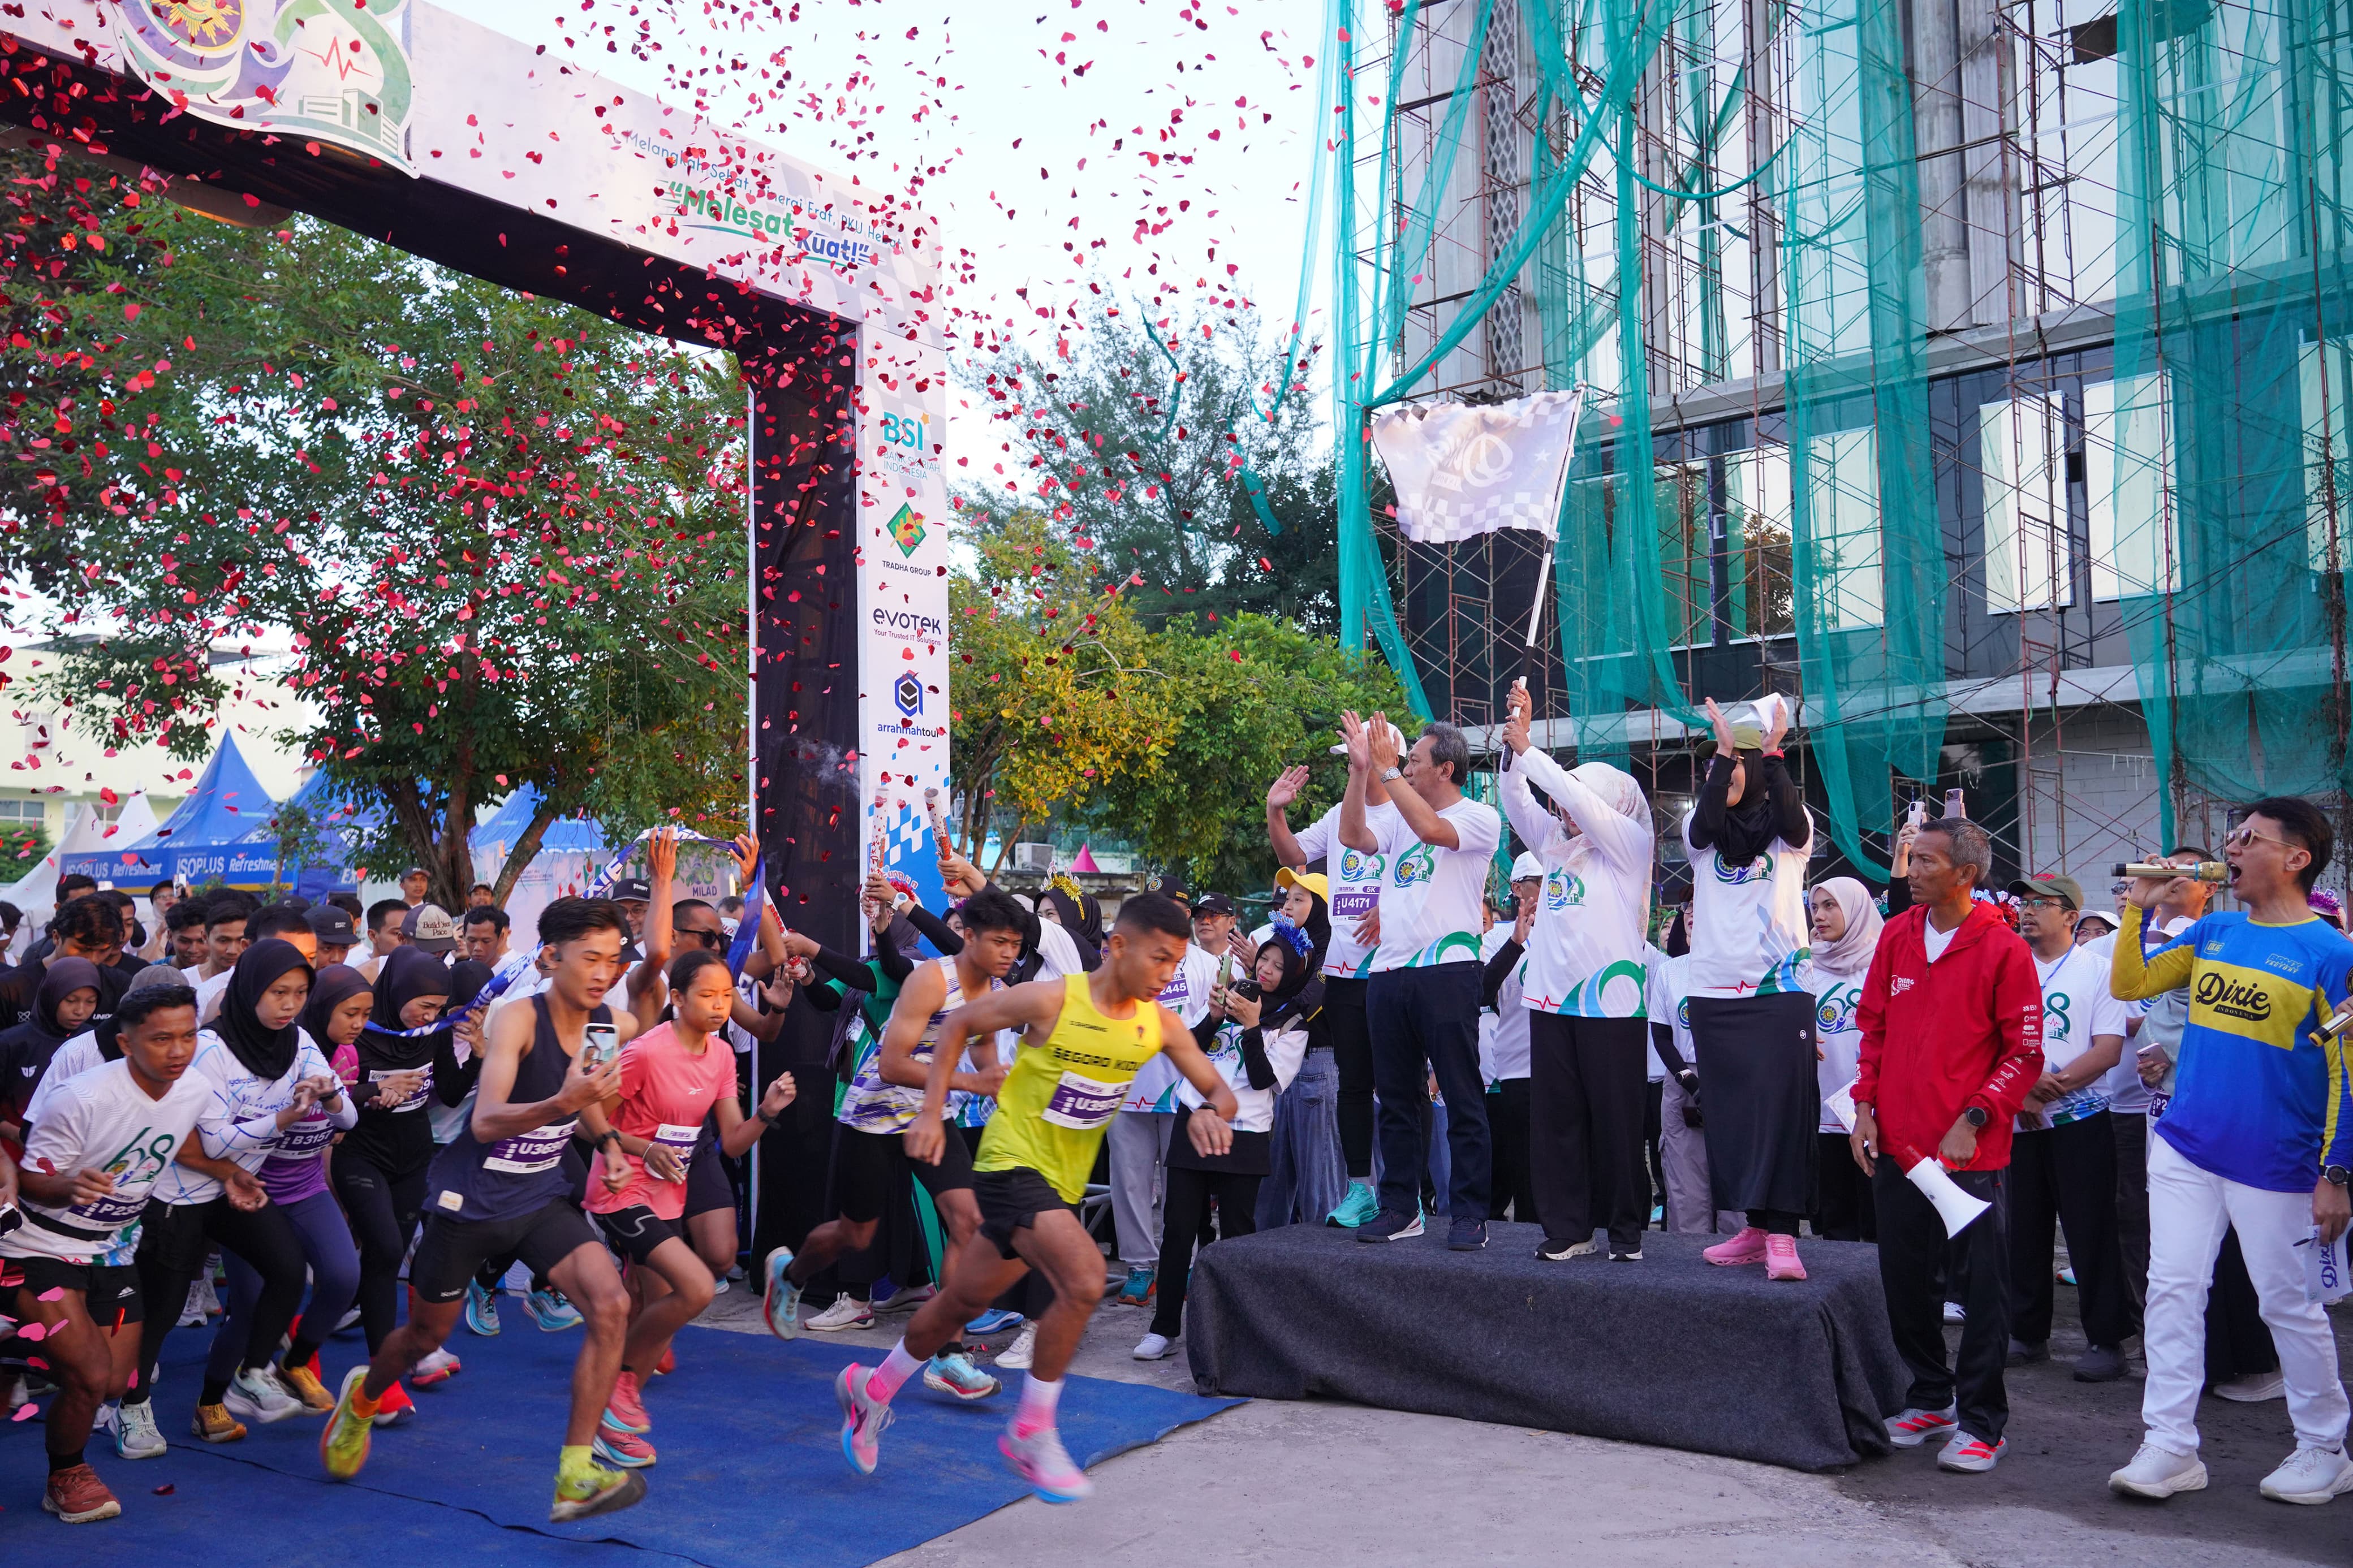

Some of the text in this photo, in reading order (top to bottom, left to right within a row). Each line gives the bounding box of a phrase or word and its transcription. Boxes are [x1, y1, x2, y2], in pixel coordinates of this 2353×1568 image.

[884, 412, 923, 451] BSI
[882, 560, 931, 577] TRADHA GROUP
[874, 628, 886, 637] Your
[889, 631, 909, 640] Trusted
[916, 636, 941, 646] Solutions
[66, 862, 109, 878] ISOPLUS
[176, 856, 287, 878] ISOPLUS Refreshmet
[692, 886, 717, 897] MILAD
[1342, 897, 1370, 908] U4171
[2265, 960, 2299, 974] FACTORY
[2195, 972, 2271, 1015] Dixie
[291, 1129, 334, 1145] B3157
